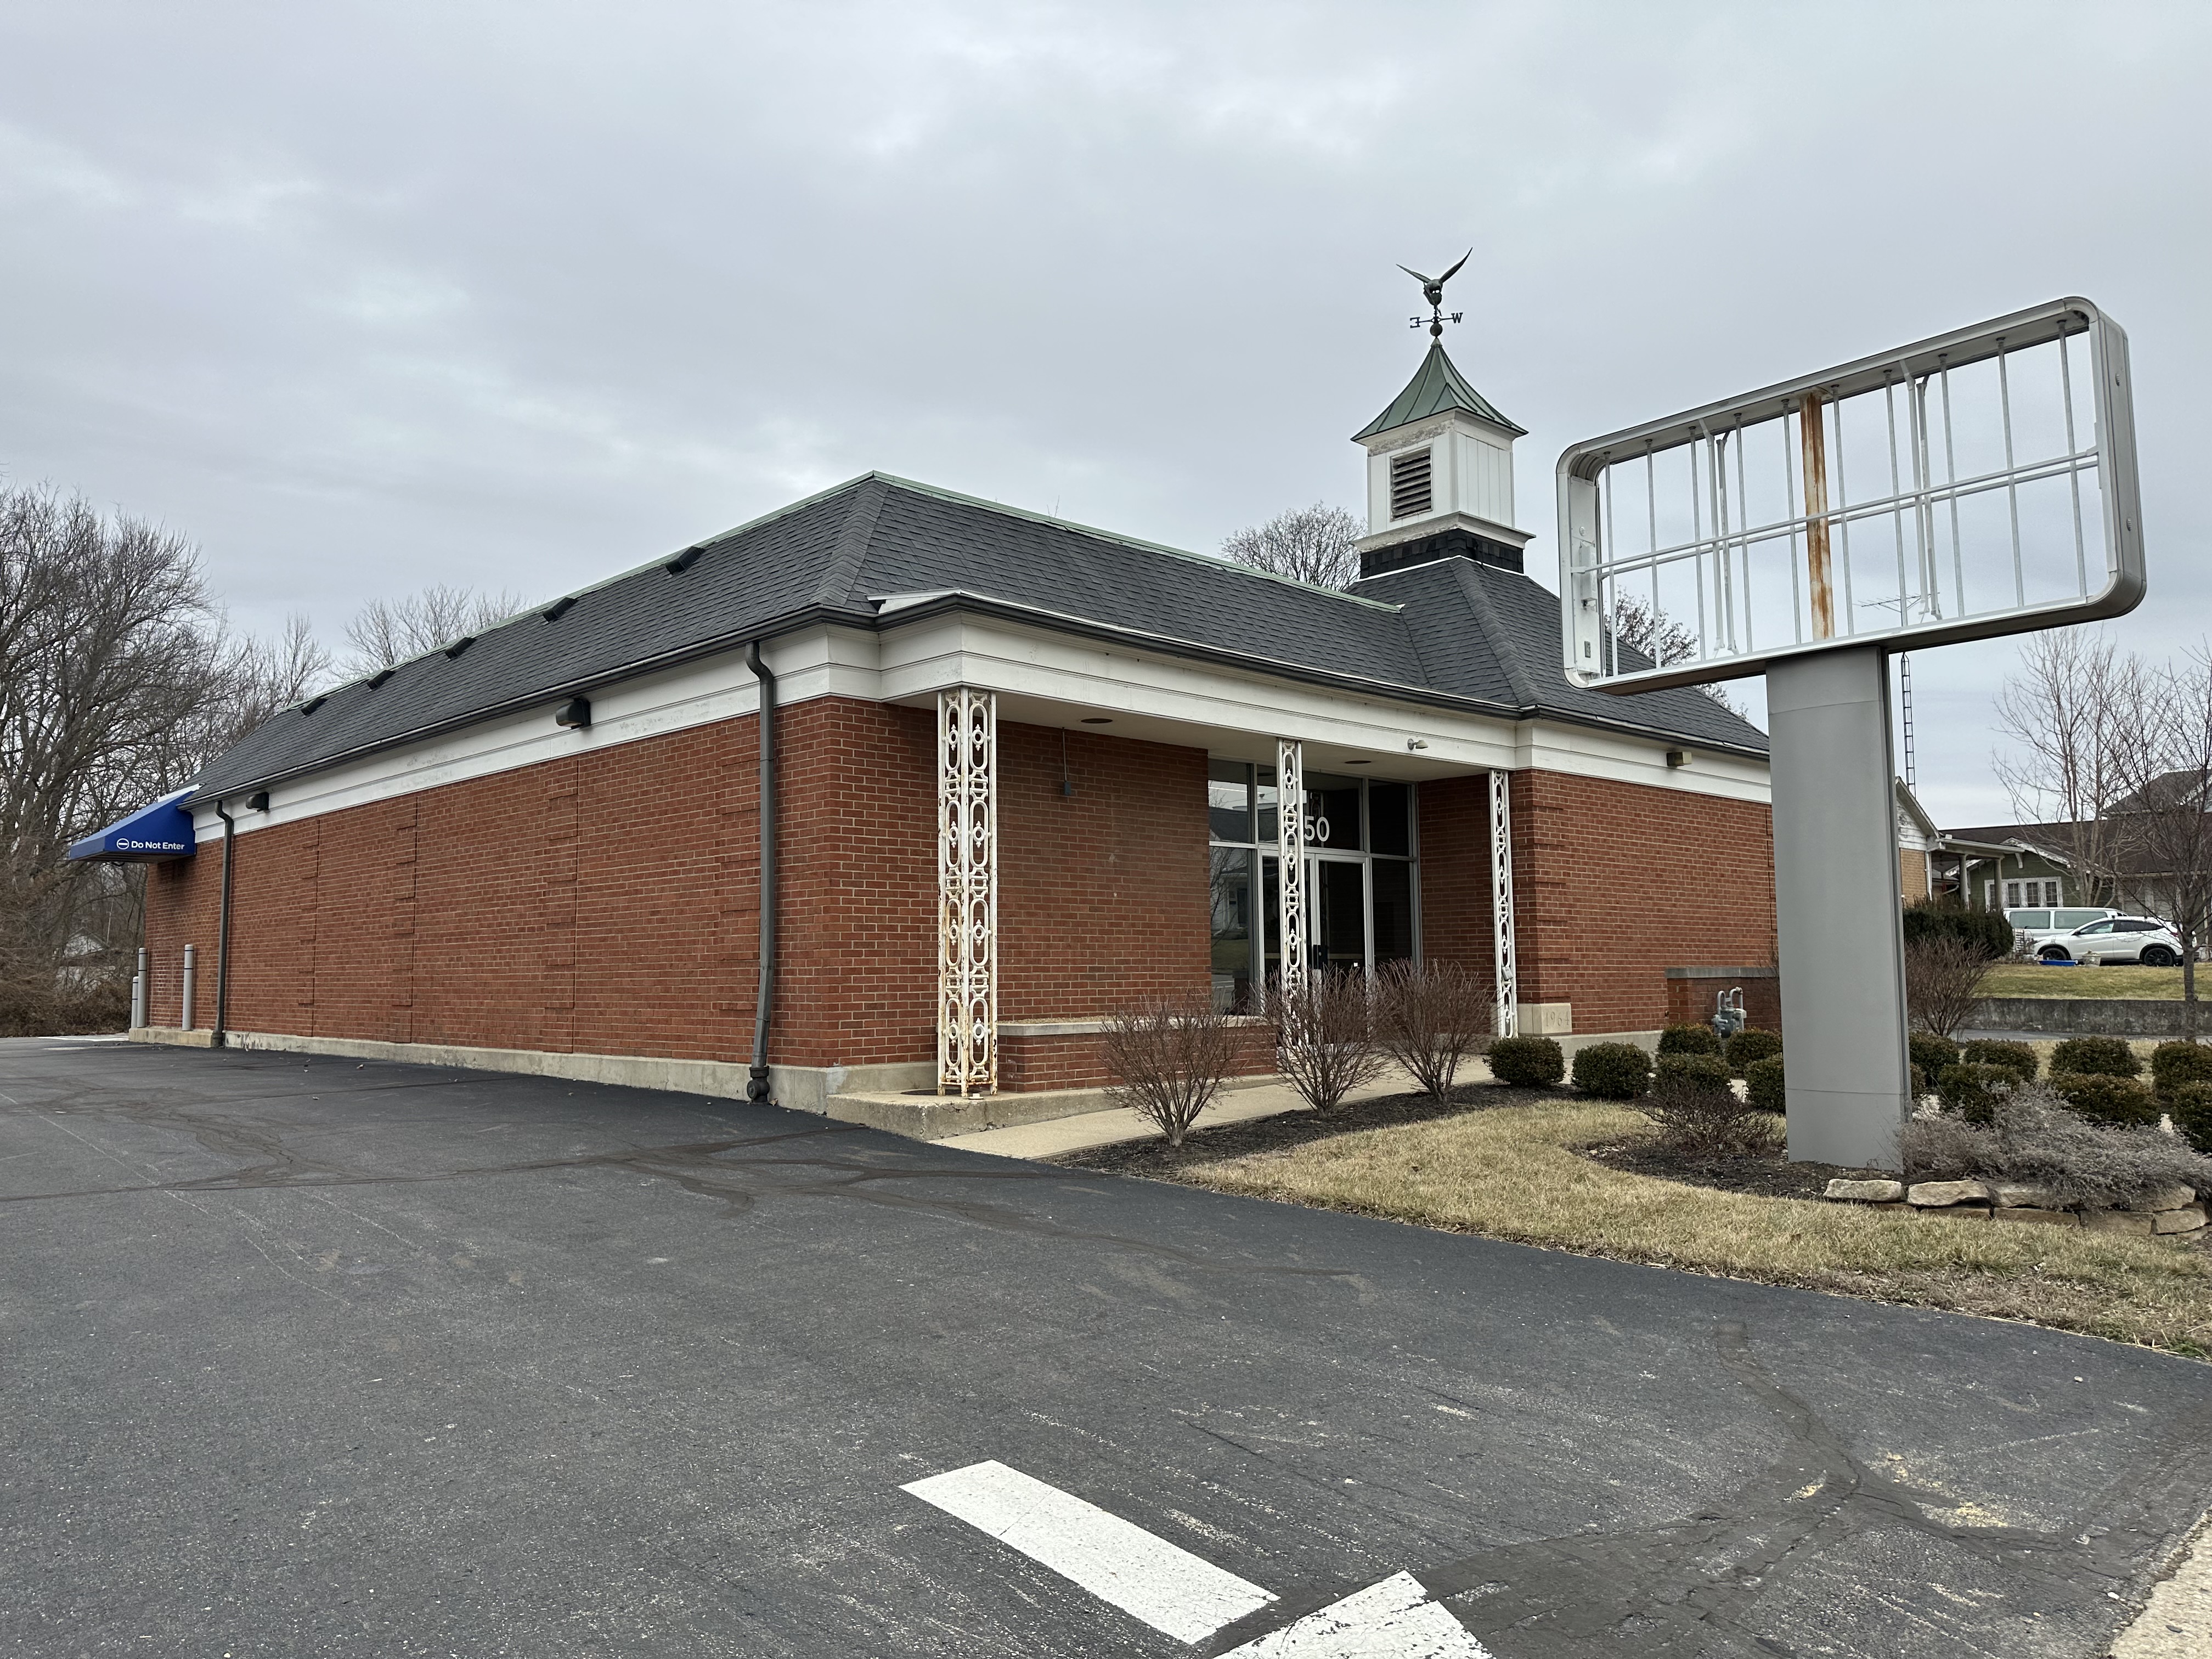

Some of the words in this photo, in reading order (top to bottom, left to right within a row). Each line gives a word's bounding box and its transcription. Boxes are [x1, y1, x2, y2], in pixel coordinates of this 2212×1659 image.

[1451, 312, 1463, 323] W
[1304, 815, 1330, 842] 50
[145, 841, 161, 849] Not
[162, 842, 185, 850] Enter
